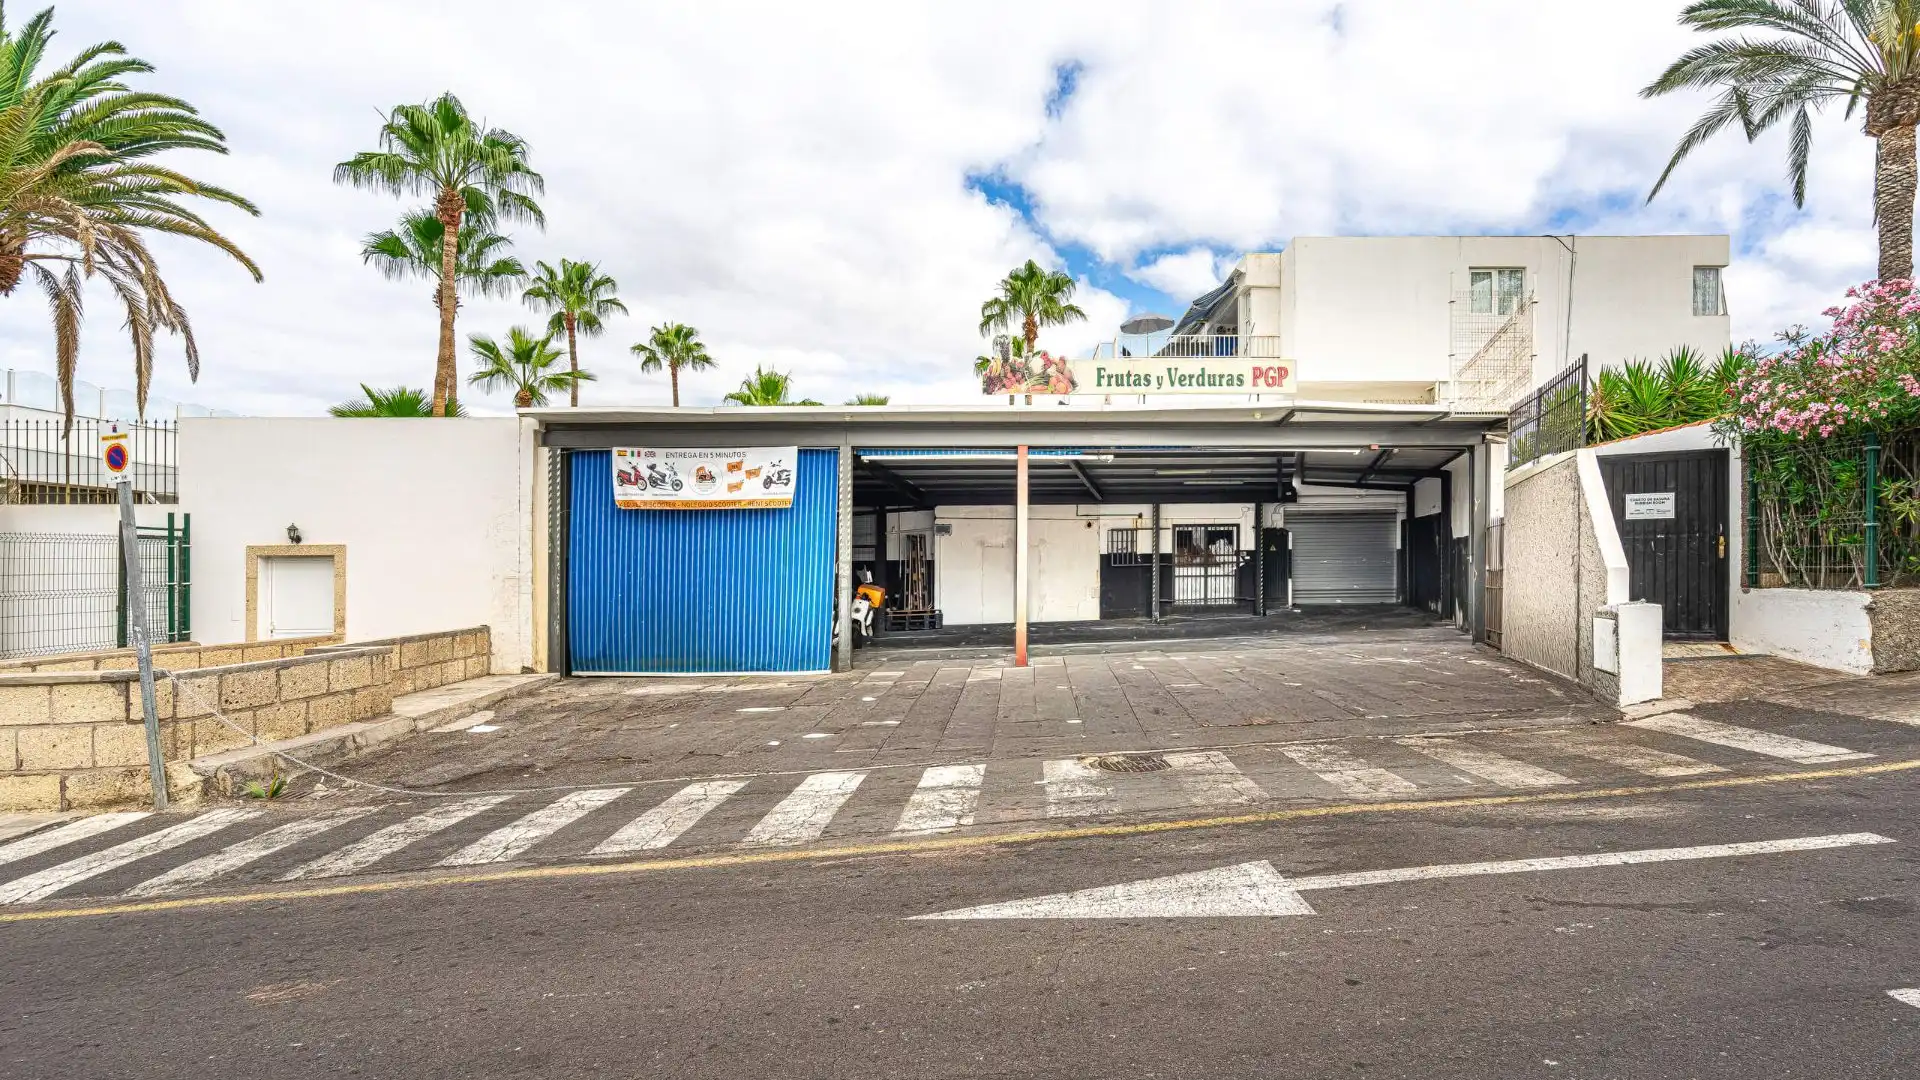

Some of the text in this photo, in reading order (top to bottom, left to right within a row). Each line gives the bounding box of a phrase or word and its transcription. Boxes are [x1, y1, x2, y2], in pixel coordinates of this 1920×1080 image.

[1096, 366, 1289, 390] Frutas y Verduras PGP
[715, 451, 747, 459] MINUTOS
